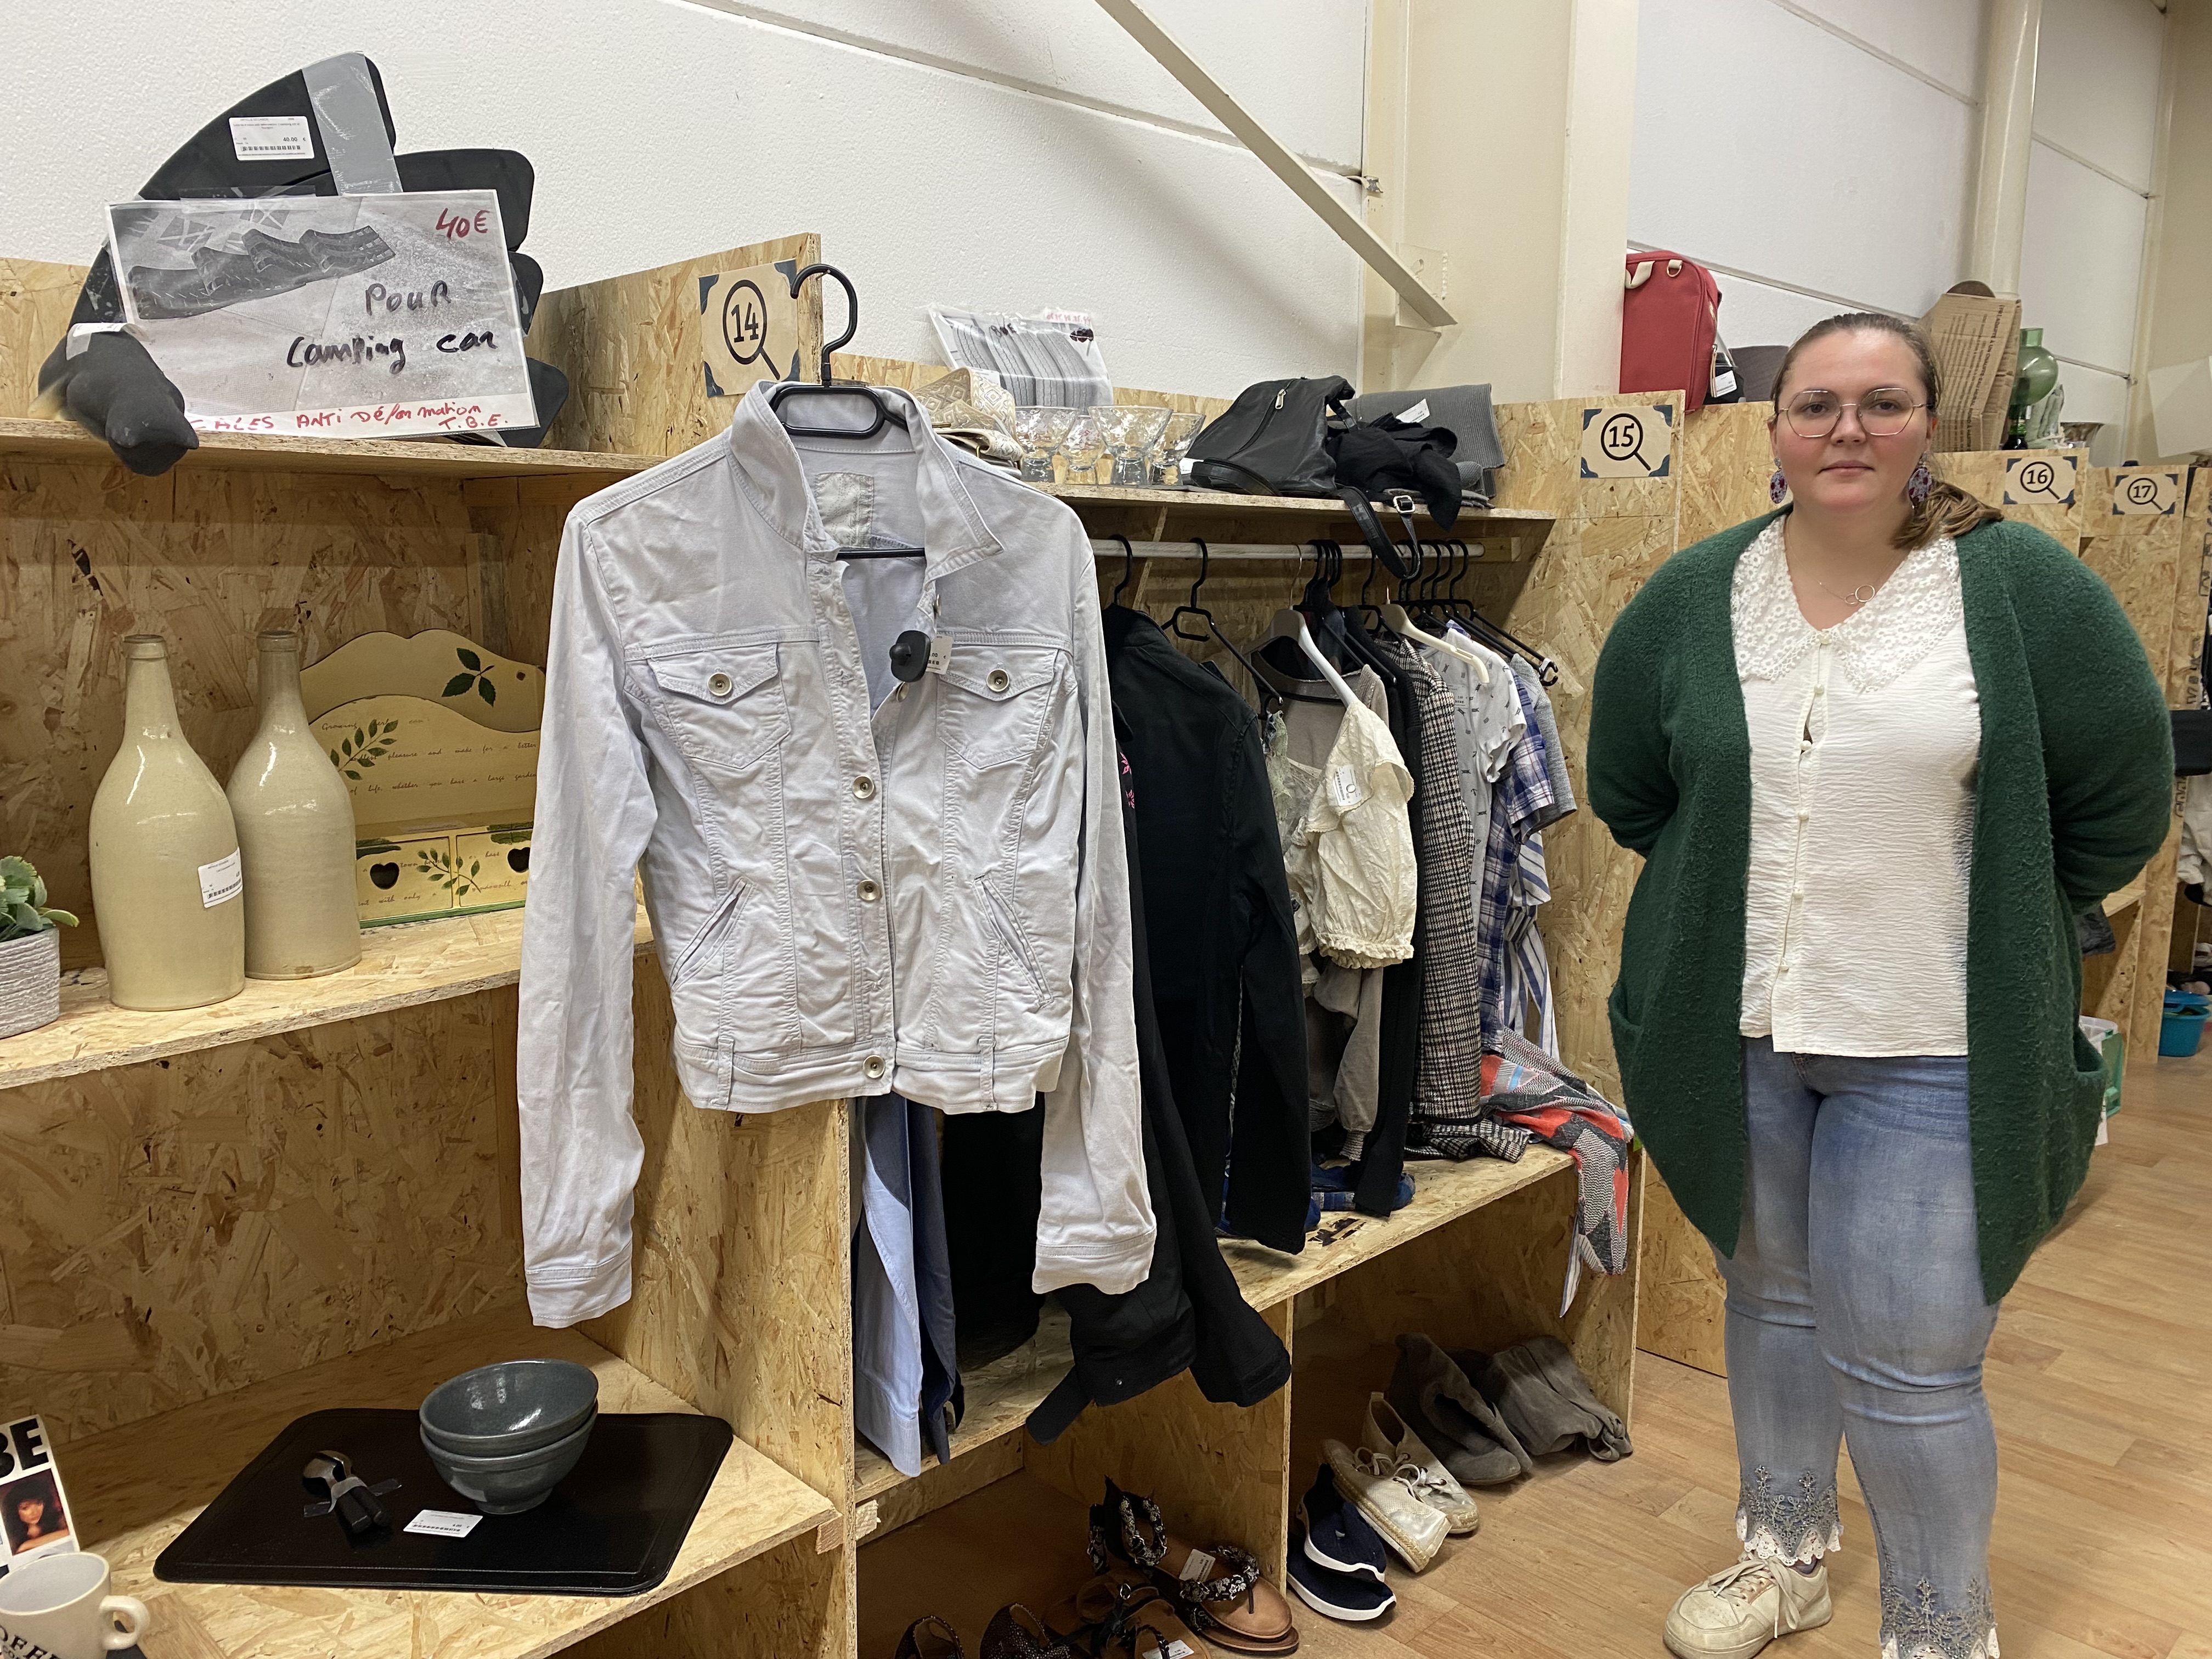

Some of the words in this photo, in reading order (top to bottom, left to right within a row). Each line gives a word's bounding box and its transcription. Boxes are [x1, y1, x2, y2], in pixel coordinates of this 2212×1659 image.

[731, 302, 759, 343] 14
[1609, 423, 1634, 447] 15
[2027, 469, 2047, 484] 16
[2133, 486, 2151, 498] 17
[388, 752, 417, 760] pleasure
[483, 744, 493, 754] for
[350, 786, 357, 795] of
[488, 774, 505, 783] large
[379, 895, 395, 903] with
[472, 880, 512, 892] wndowsill
